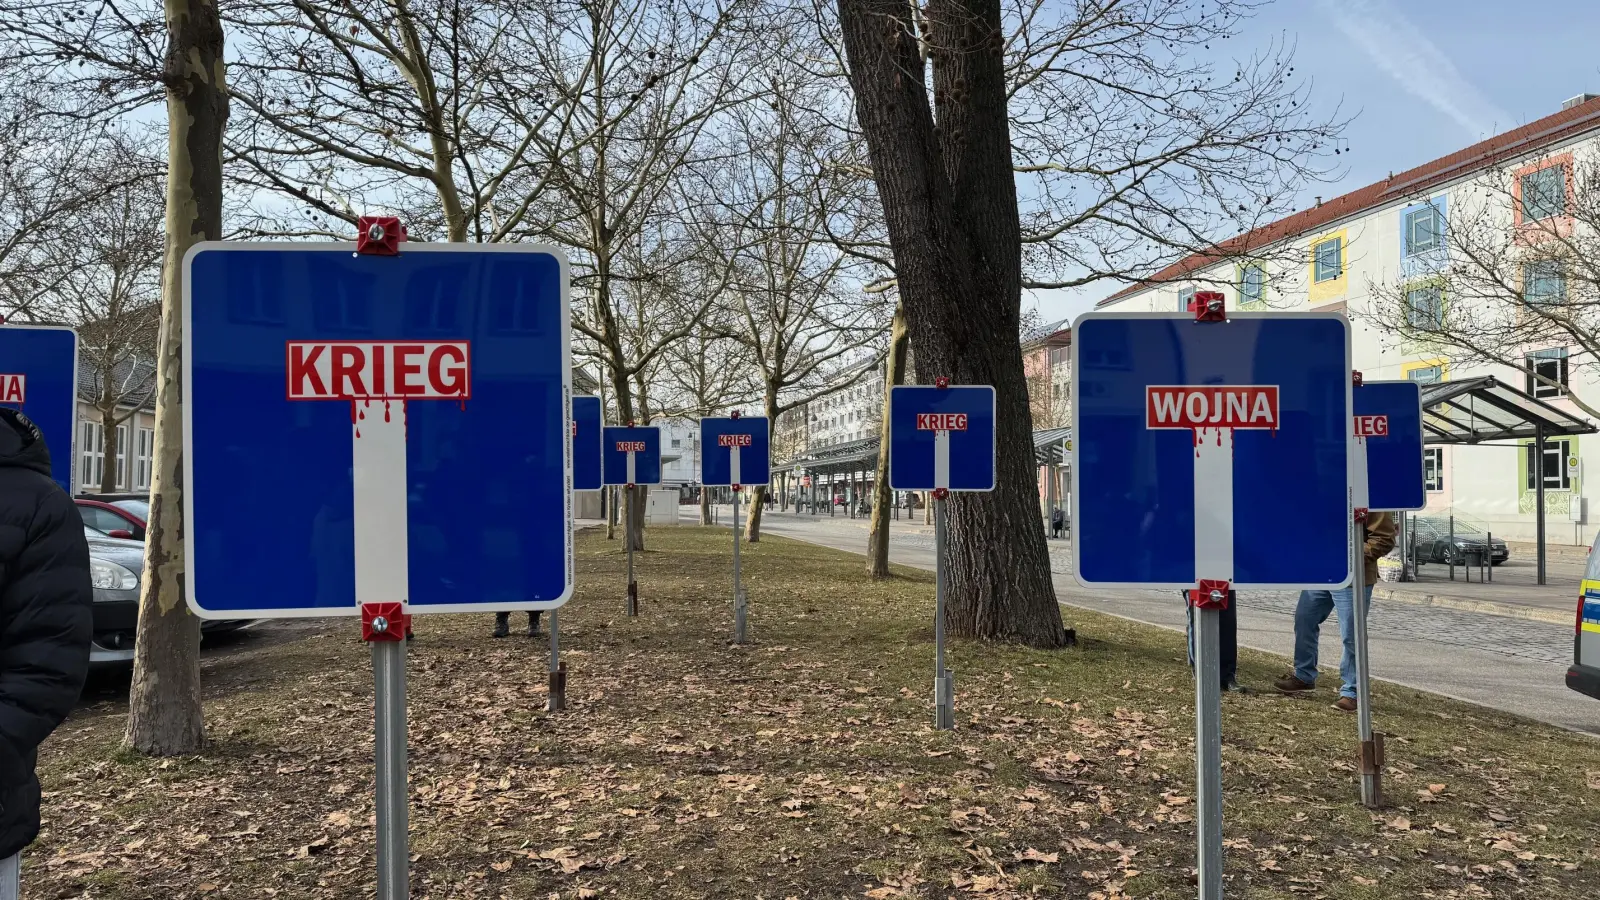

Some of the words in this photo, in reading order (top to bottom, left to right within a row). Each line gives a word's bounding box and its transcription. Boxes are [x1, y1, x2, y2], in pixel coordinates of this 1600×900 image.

[290, 344, 466, 396] KRIEG
[0, 375, 23, 401] A
[1151, 391, 1275, 423] WOJNA
[917, 414, 967, 429] KRIEG
[1353, 416, 1387, 435] IEG
[617, 442, 645, 451] KRIEG
[719, 435, 751, 445] KRIEG
